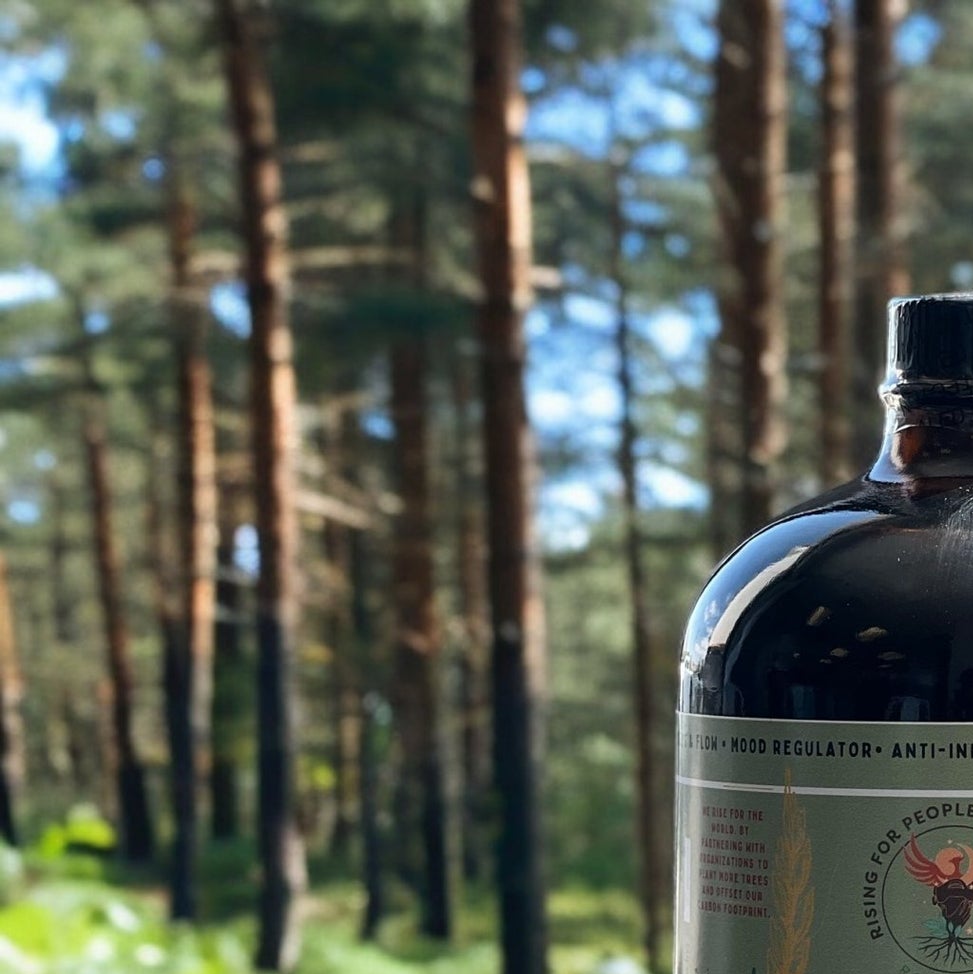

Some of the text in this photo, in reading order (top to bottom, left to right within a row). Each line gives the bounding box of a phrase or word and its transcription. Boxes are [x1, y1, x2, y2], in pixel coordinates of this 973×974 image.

[731, 737, 767, 754] MOOD
[773, 739, 872, 759] REGULATOR
[729, 808, 745, 820] FOR
[748, 809, 764, 821] THE
[739, 825, 750, 837] BY
[745, 842, 766, 854] WITH
[870, 829, 902, 866] FOR
[758, 859, 769, 870] TO
[741, 873, 769, 887] TREES
[745, 890, 763, 901] OUR
[863, 871, 885, 941] RISING
